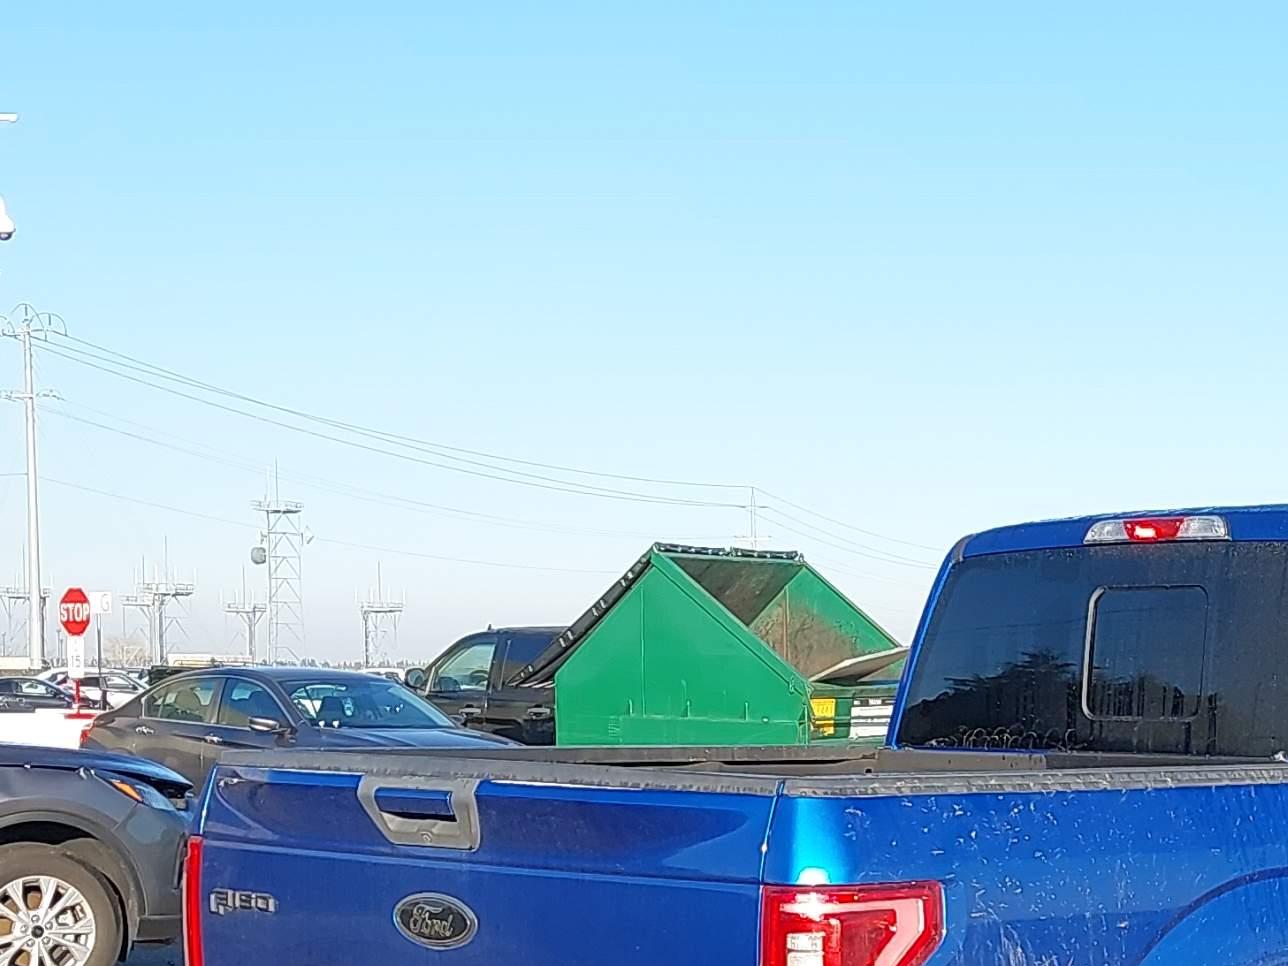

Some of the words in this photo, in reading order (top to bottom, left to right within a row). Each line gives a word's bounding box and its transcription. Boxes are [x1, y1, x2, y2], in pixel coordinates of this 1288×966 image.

[60, 602, 90, 622] STOP
[71, 655, 81, 668] 15
[409, 903, 454, 937] Ford
